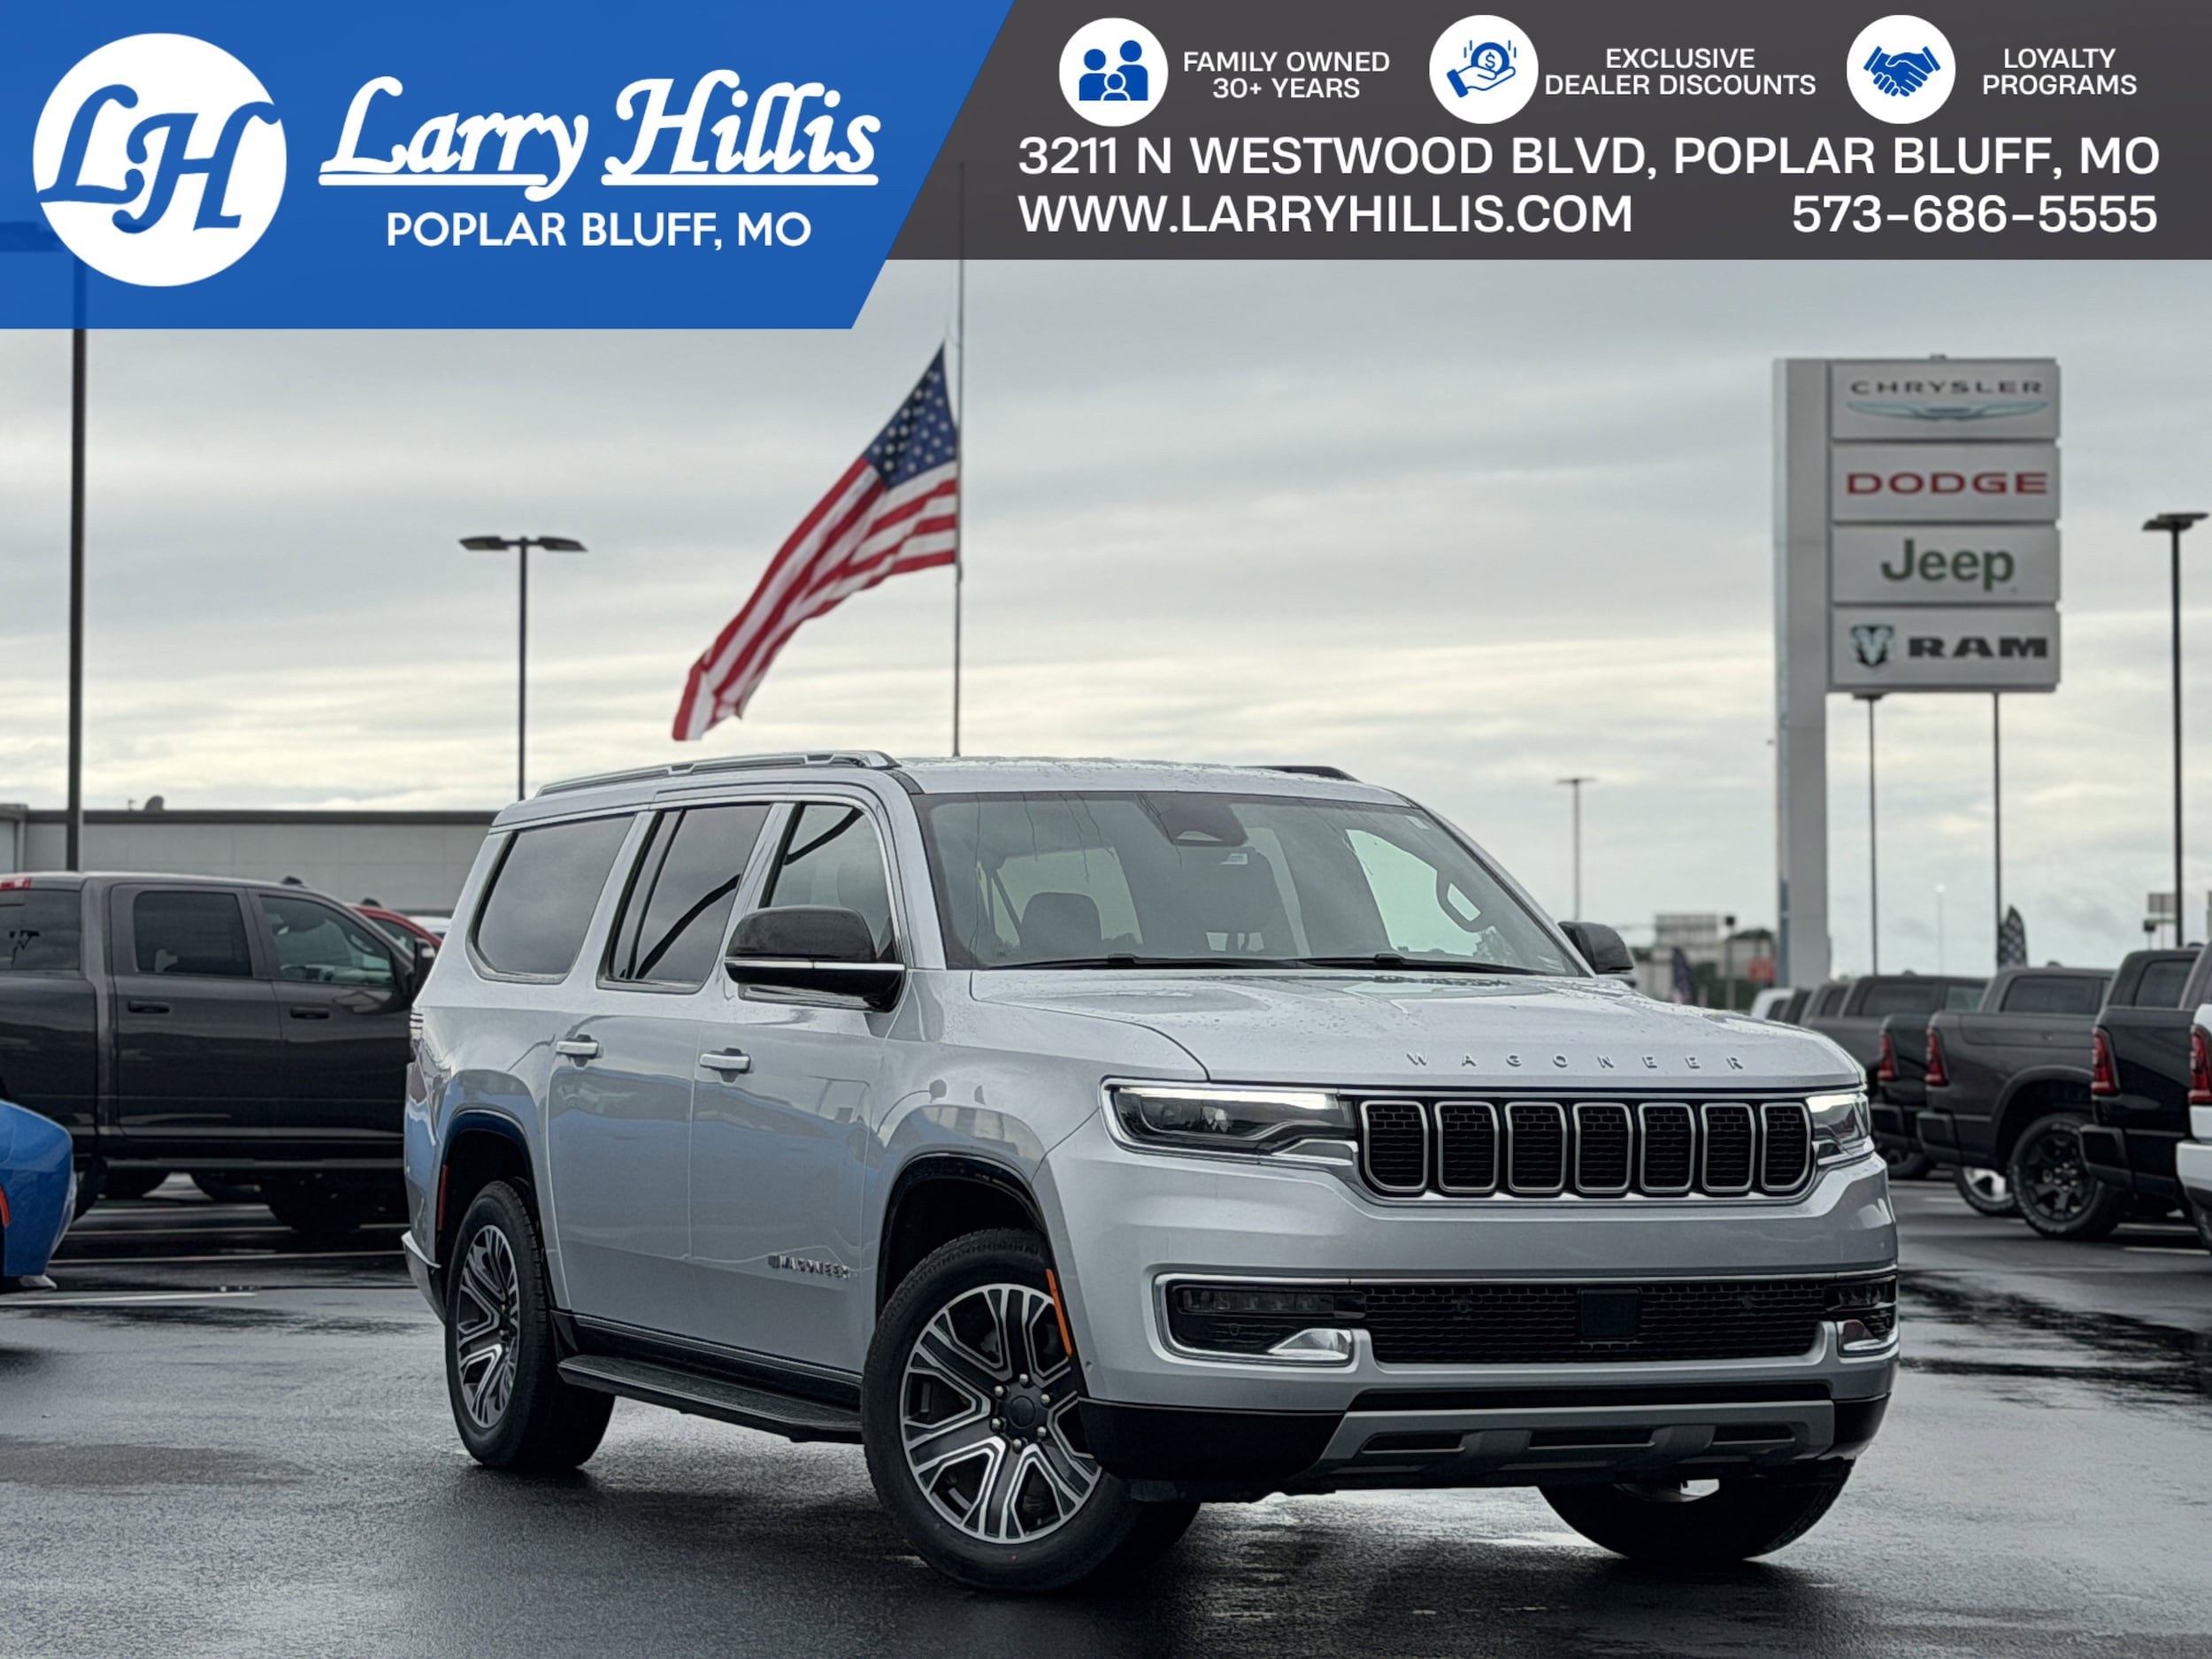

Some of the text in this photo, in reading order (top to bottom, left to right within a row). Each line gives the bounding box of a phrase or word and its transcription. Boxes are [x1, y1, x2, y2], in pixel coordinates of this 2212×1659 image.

[1850, 380, 2043, 395] CHRYSLER
[1847, 472, 2048, 495] DODGE
[1880, 538, 2016, 592] Jeep
[1908, 636, 2048, 658] RAM
[1406, 1052, 1744, 1071] WAGONEER
